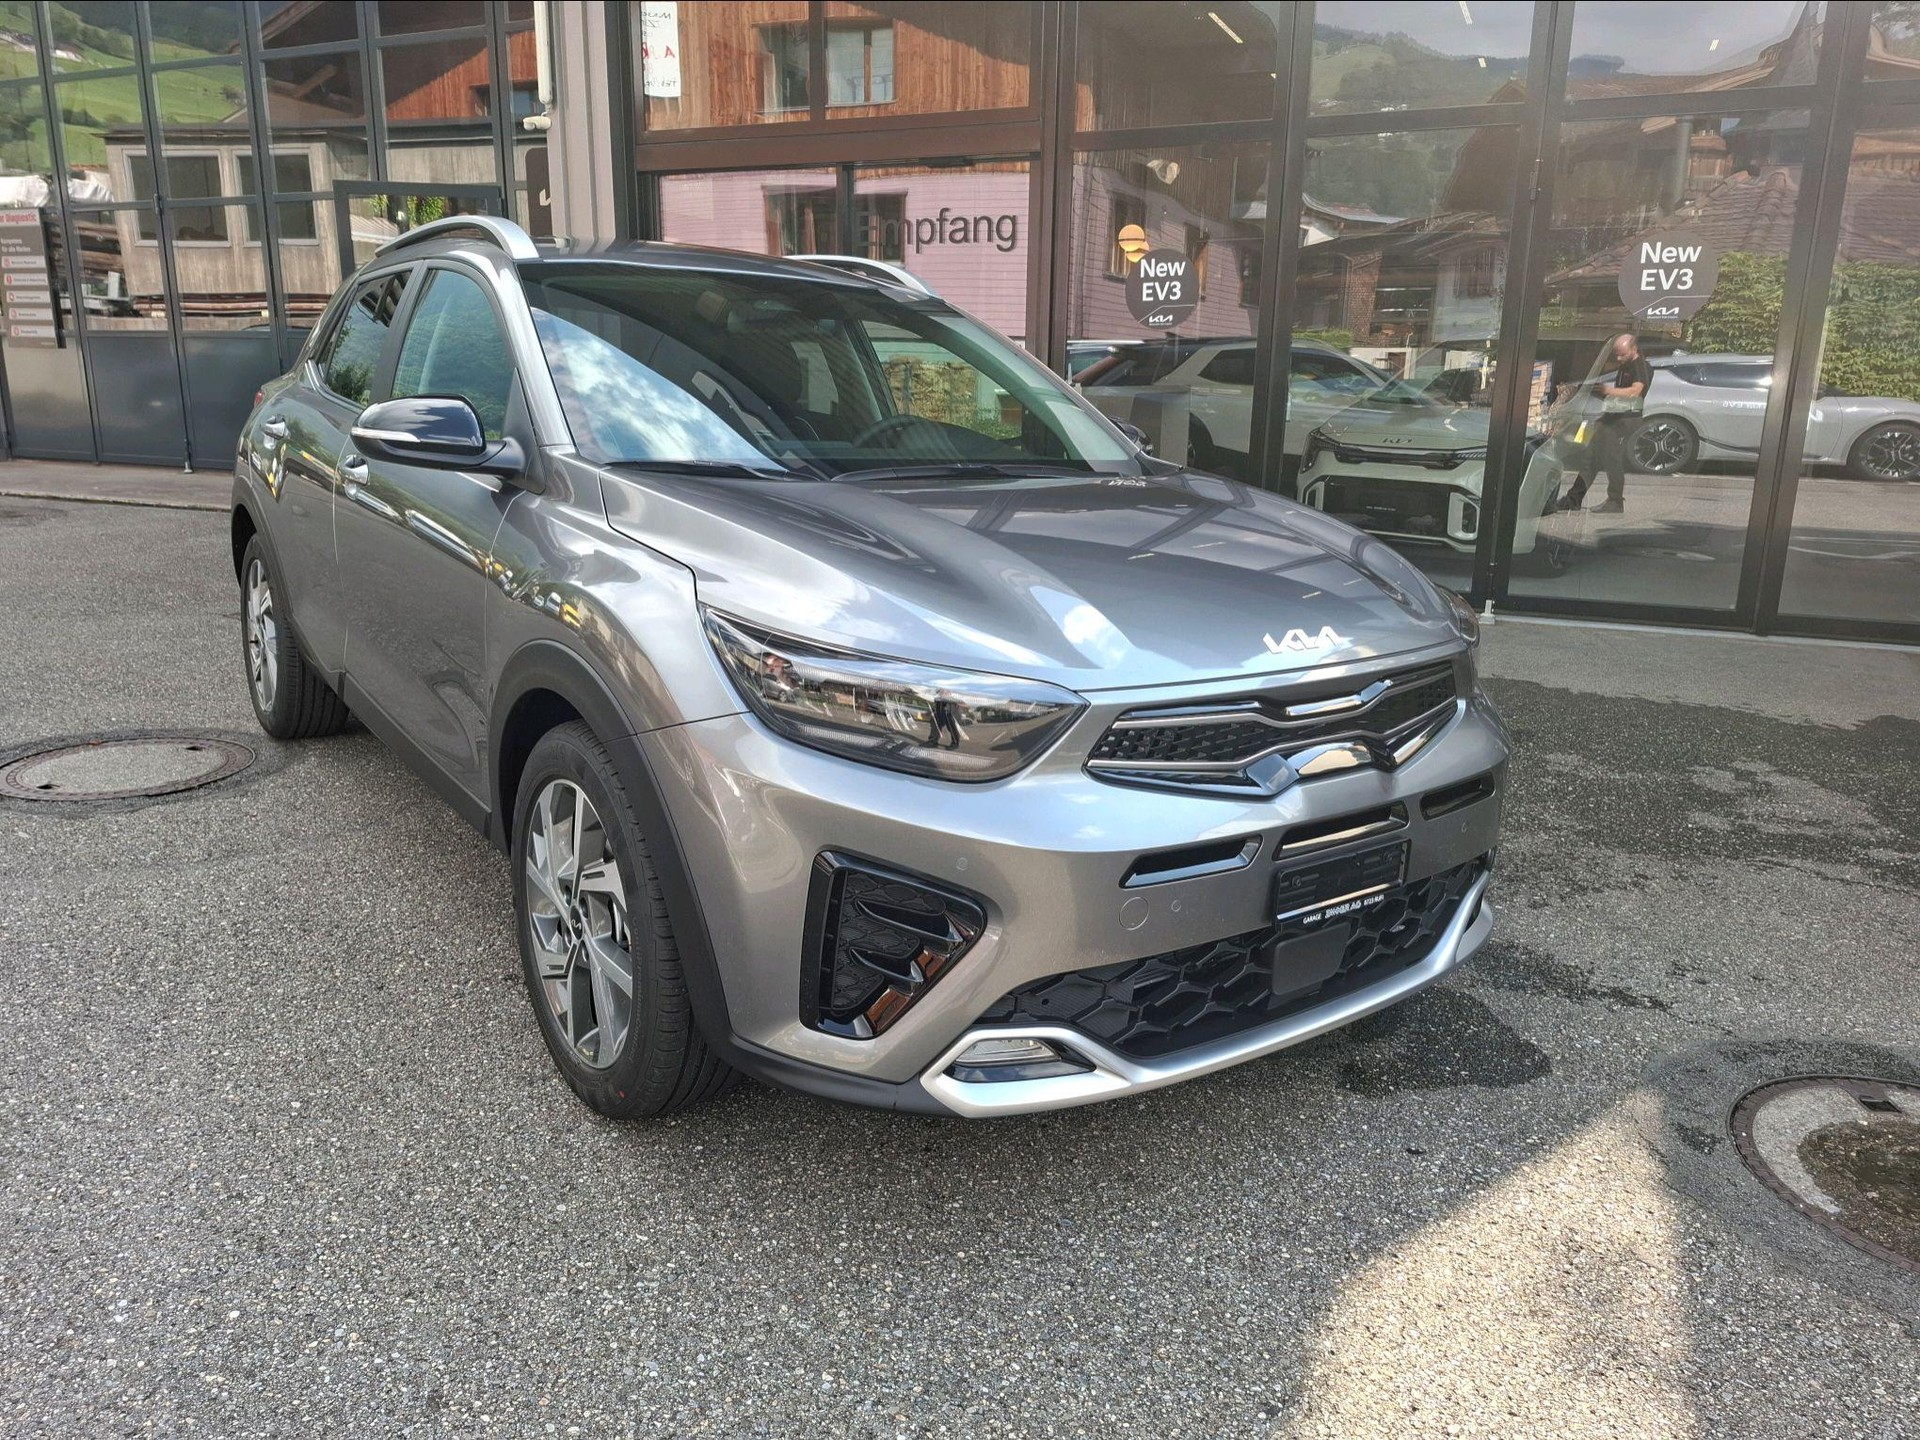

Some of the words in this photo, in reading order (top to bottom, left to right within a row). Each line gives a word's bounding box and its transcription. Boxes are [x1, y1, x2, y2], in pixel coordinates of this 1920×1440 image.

[856, 207, 1017, 253] Empfang
[1640, 242, 1702, 264] New
[1140, 258, 1186, 279] New
[1640, 268, 1694, 291] EV3
[1142, 281, 1182, 302] EV3
[1148, 314, 1174, 323] KIA
[1647, 306, 1680, 315] KIA
[1262, 625, 1342, 655] KIA
